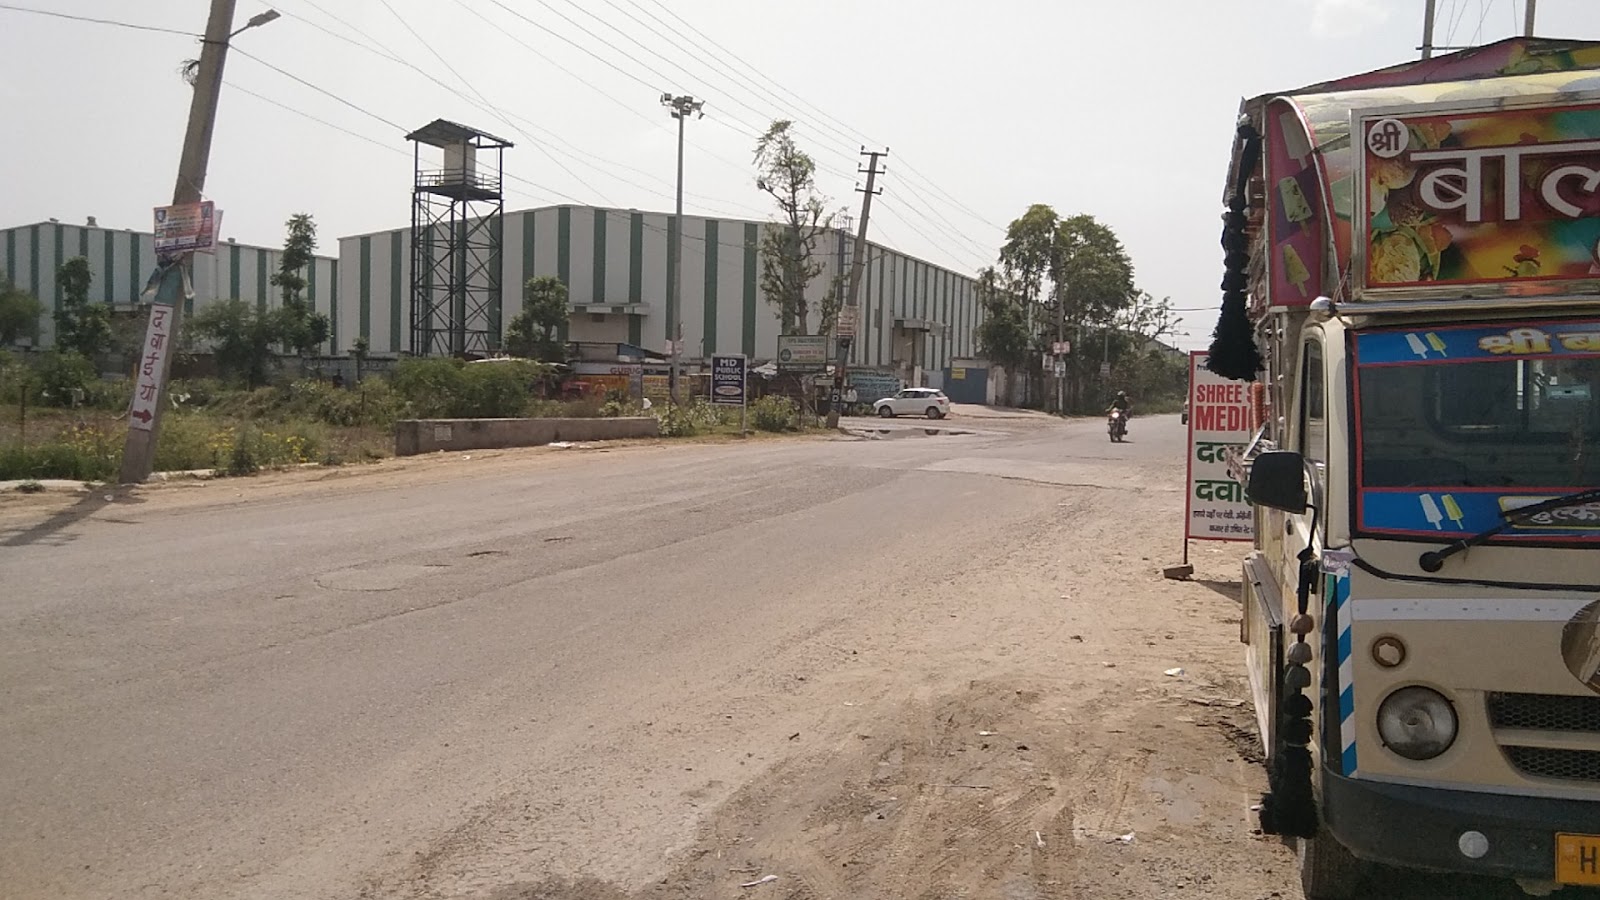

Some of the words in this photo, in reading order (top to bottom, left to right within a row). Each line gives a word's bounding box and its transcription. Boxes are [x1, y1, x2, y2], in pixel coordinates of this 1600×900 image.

[1371, 122, 1401, 151] श्री
[1478, 327, 1552, 355] श्री
[720, 359, 737, 367] MD
[1197, 384, 1242, 403] SHREE
[1196, 406, 1252, 431] MEDI
